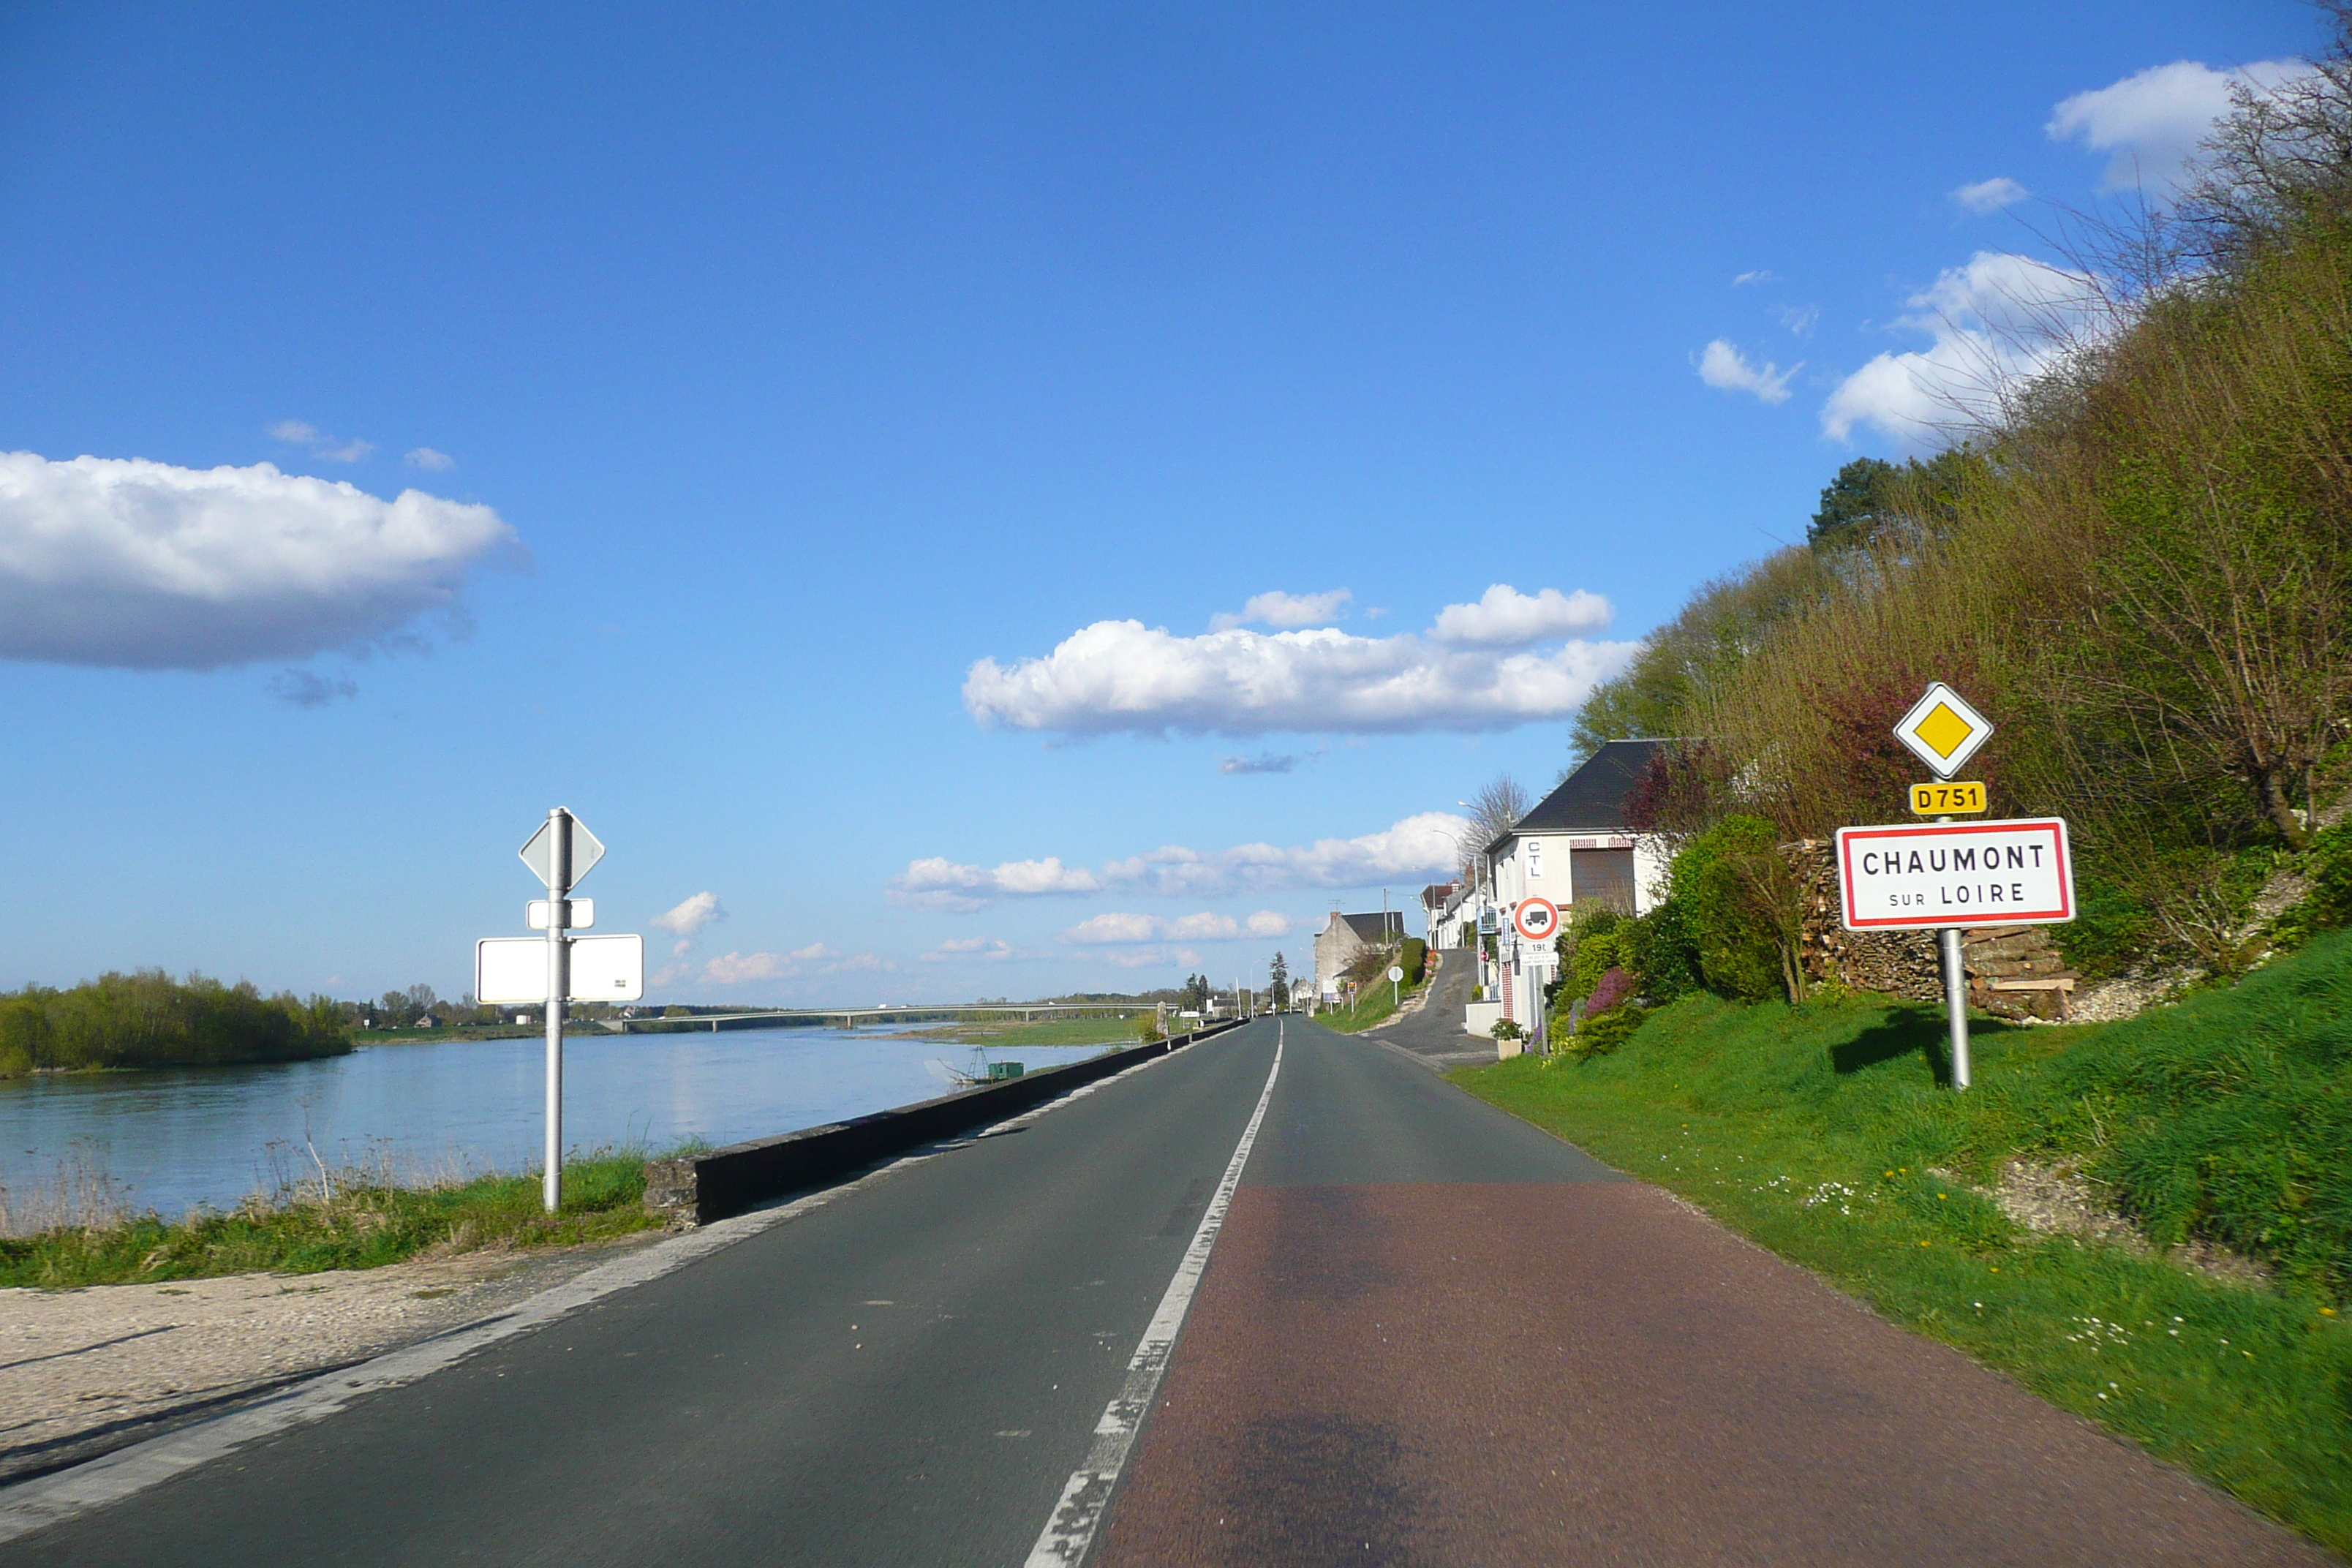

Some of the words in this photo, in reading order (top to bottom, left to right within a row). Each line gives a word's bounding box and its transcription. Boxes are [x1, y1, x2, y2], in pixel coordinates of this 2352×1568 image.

[1918, 788, 1978, 809] D751
[1863, 845, 2043, 875] CHAUMONT
[1889, 894, 1925, 906] SUR
[1941, 883, 2024, 905] LOIRE
